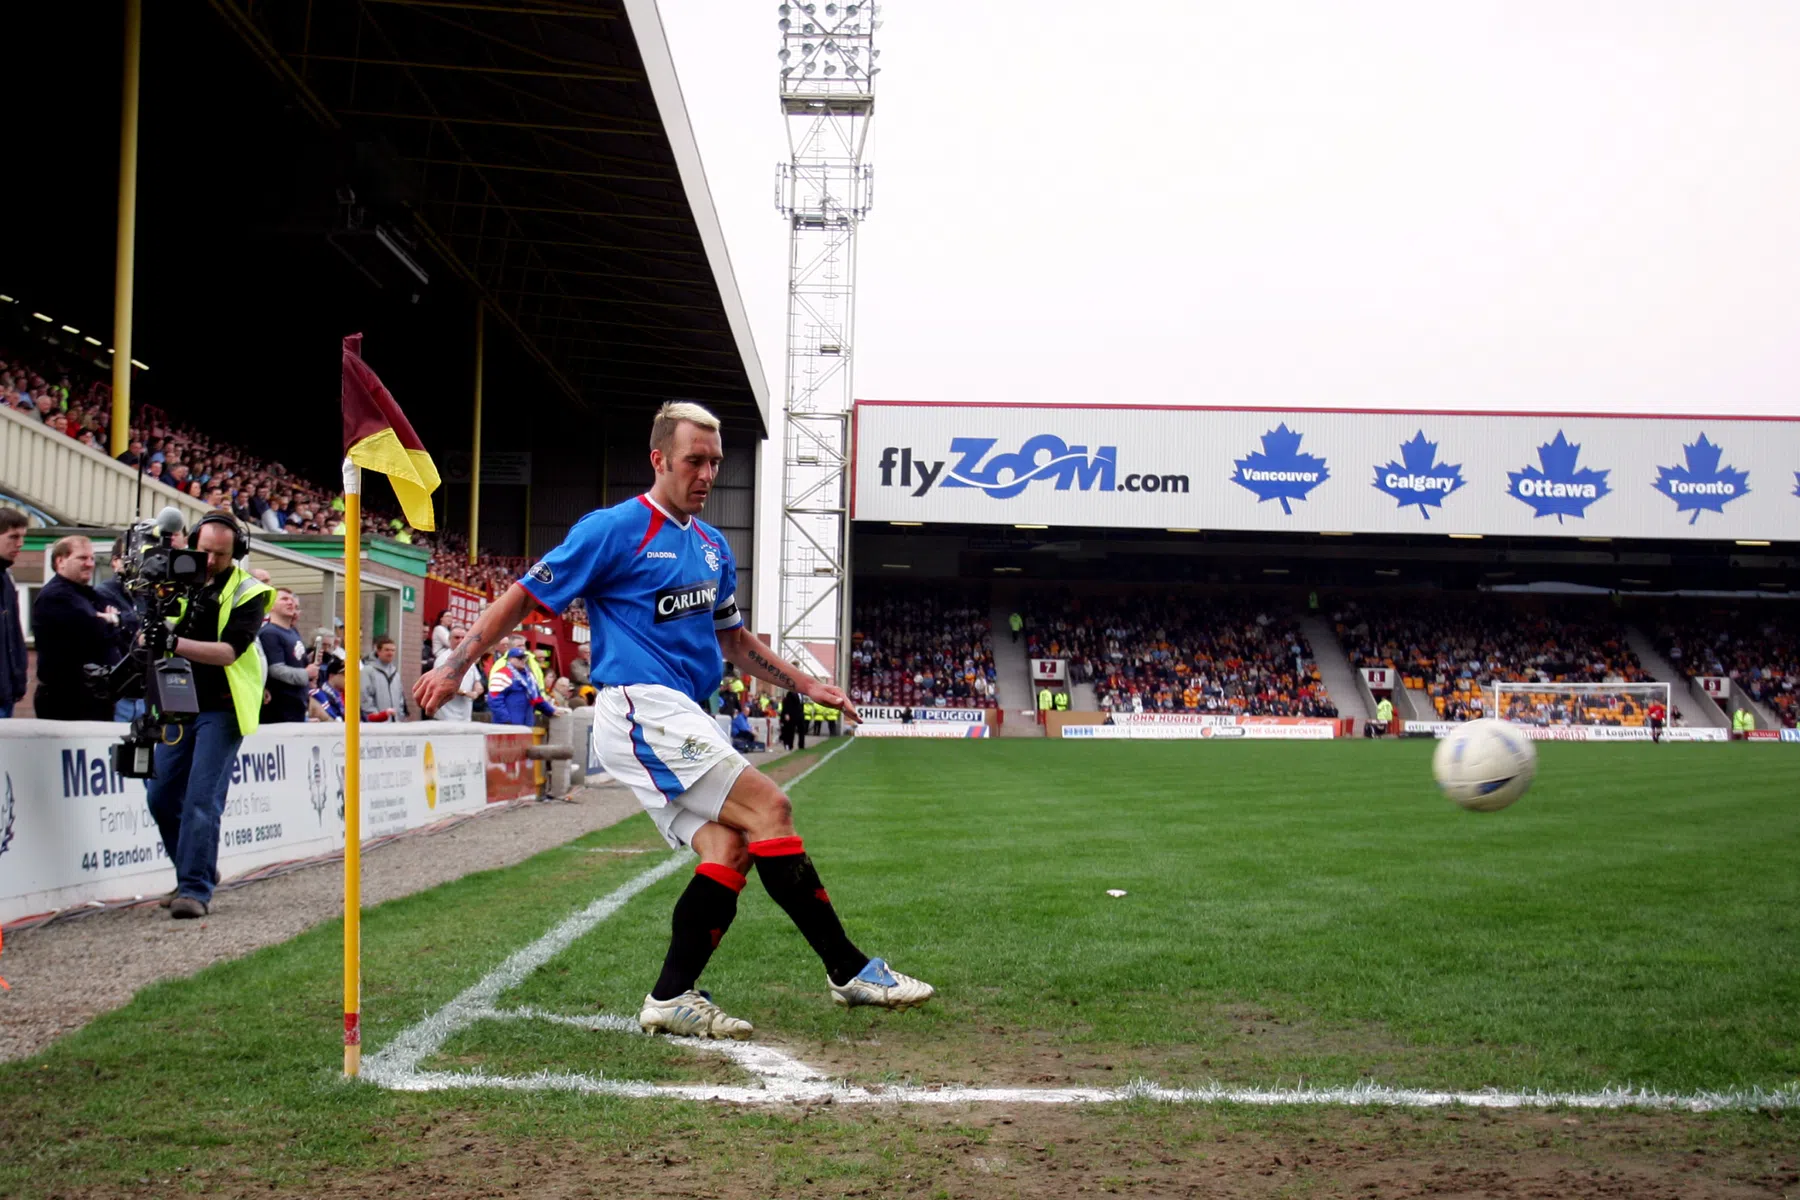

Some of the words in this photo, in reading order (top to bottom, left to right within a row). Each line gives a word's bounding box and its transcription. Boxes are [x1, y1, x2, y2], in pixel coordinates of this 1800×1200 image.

[1242, 467, 1319, 483] Vancouver
[1385, 474, 1454, 492] Calgary
[1518, 479, 1596, 499] Ottawa
[1669, 480, 1734, 495] Toronto
[646, 551, 677, 559] DIADORA
[657, 587, 717, 615] CARLING
[1045, 663, 1051, 673] 7
[1709, 681, 1716, 690] 9
[925, 710, 980, 720] PEUGEOT
[1126, 713, 1155, 722] JOHN
[1160, 715, 1203, 724] HUGHES
[230, 744, 286, 785] erwell
[81, 851, 99, 871] 44
[103, 844, 153, 869] Brandon
[224, 827, 253, 847] 01698
